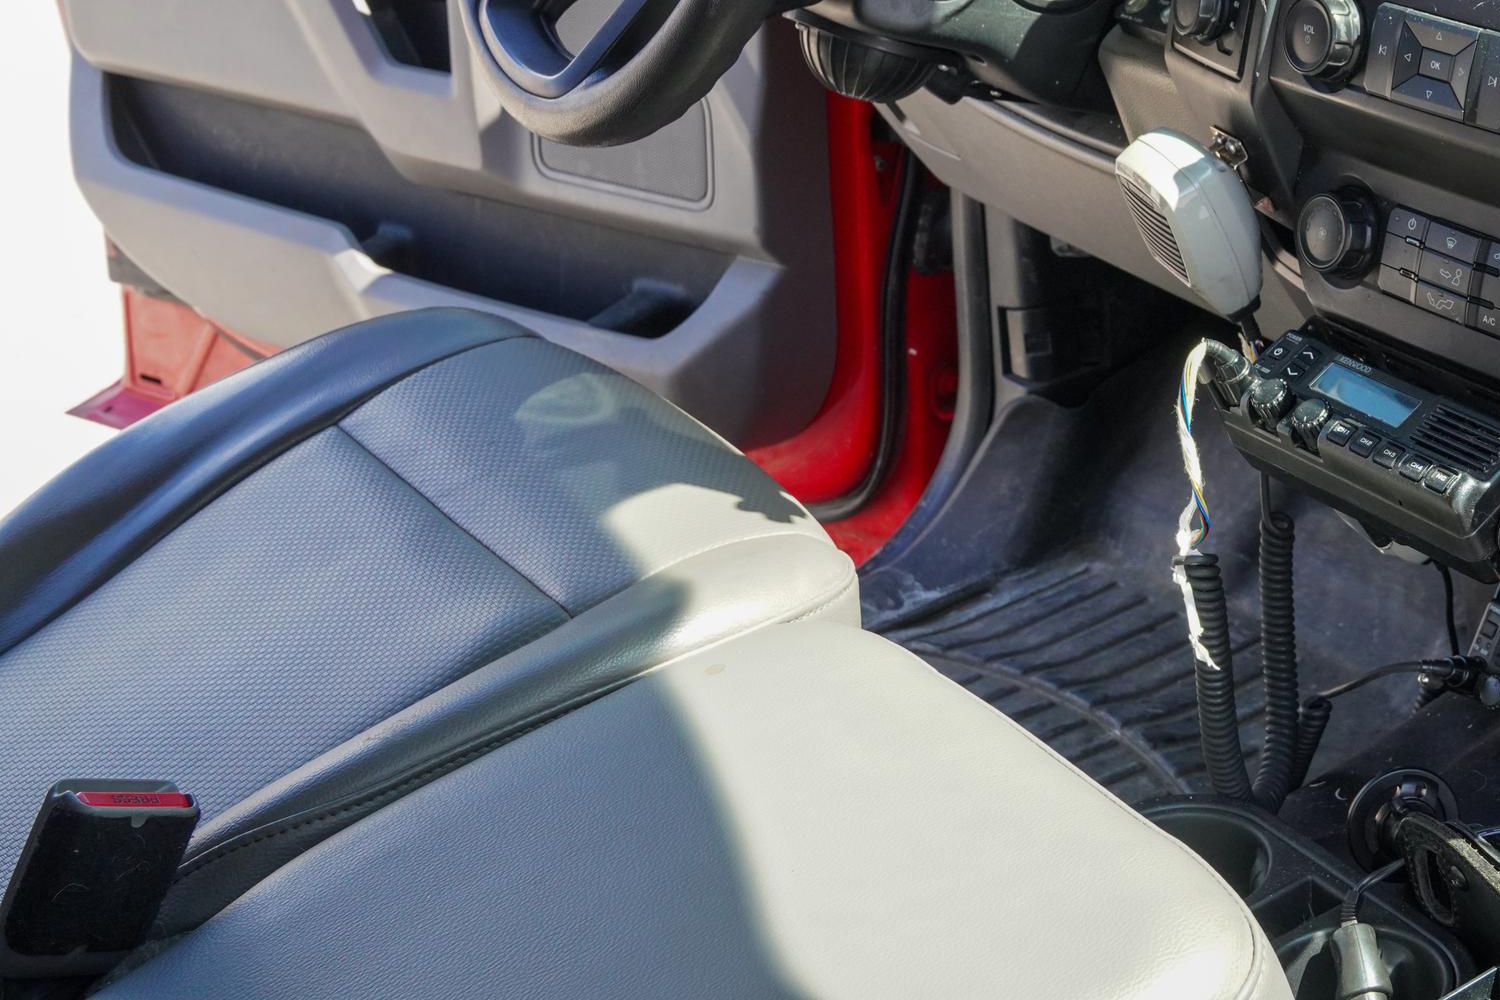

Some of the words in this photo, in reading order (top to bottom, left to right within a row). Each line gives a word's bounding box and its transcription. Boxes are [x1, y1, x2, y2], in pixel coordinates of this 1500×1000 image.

[1303, 23, 1315, 34] VOL
[1430, 61, 1441, 70] OK
[1482, 315, 1496, 326] A/C
[1340, 355, 1372, 373] KENWOOD
[1337, 426, 1350, 435] CH1
[1359, 437, 1373, 447] CH2
[1383, 448, 1397, 458] CH3
[1410, 461, 1424, 470] CH4
